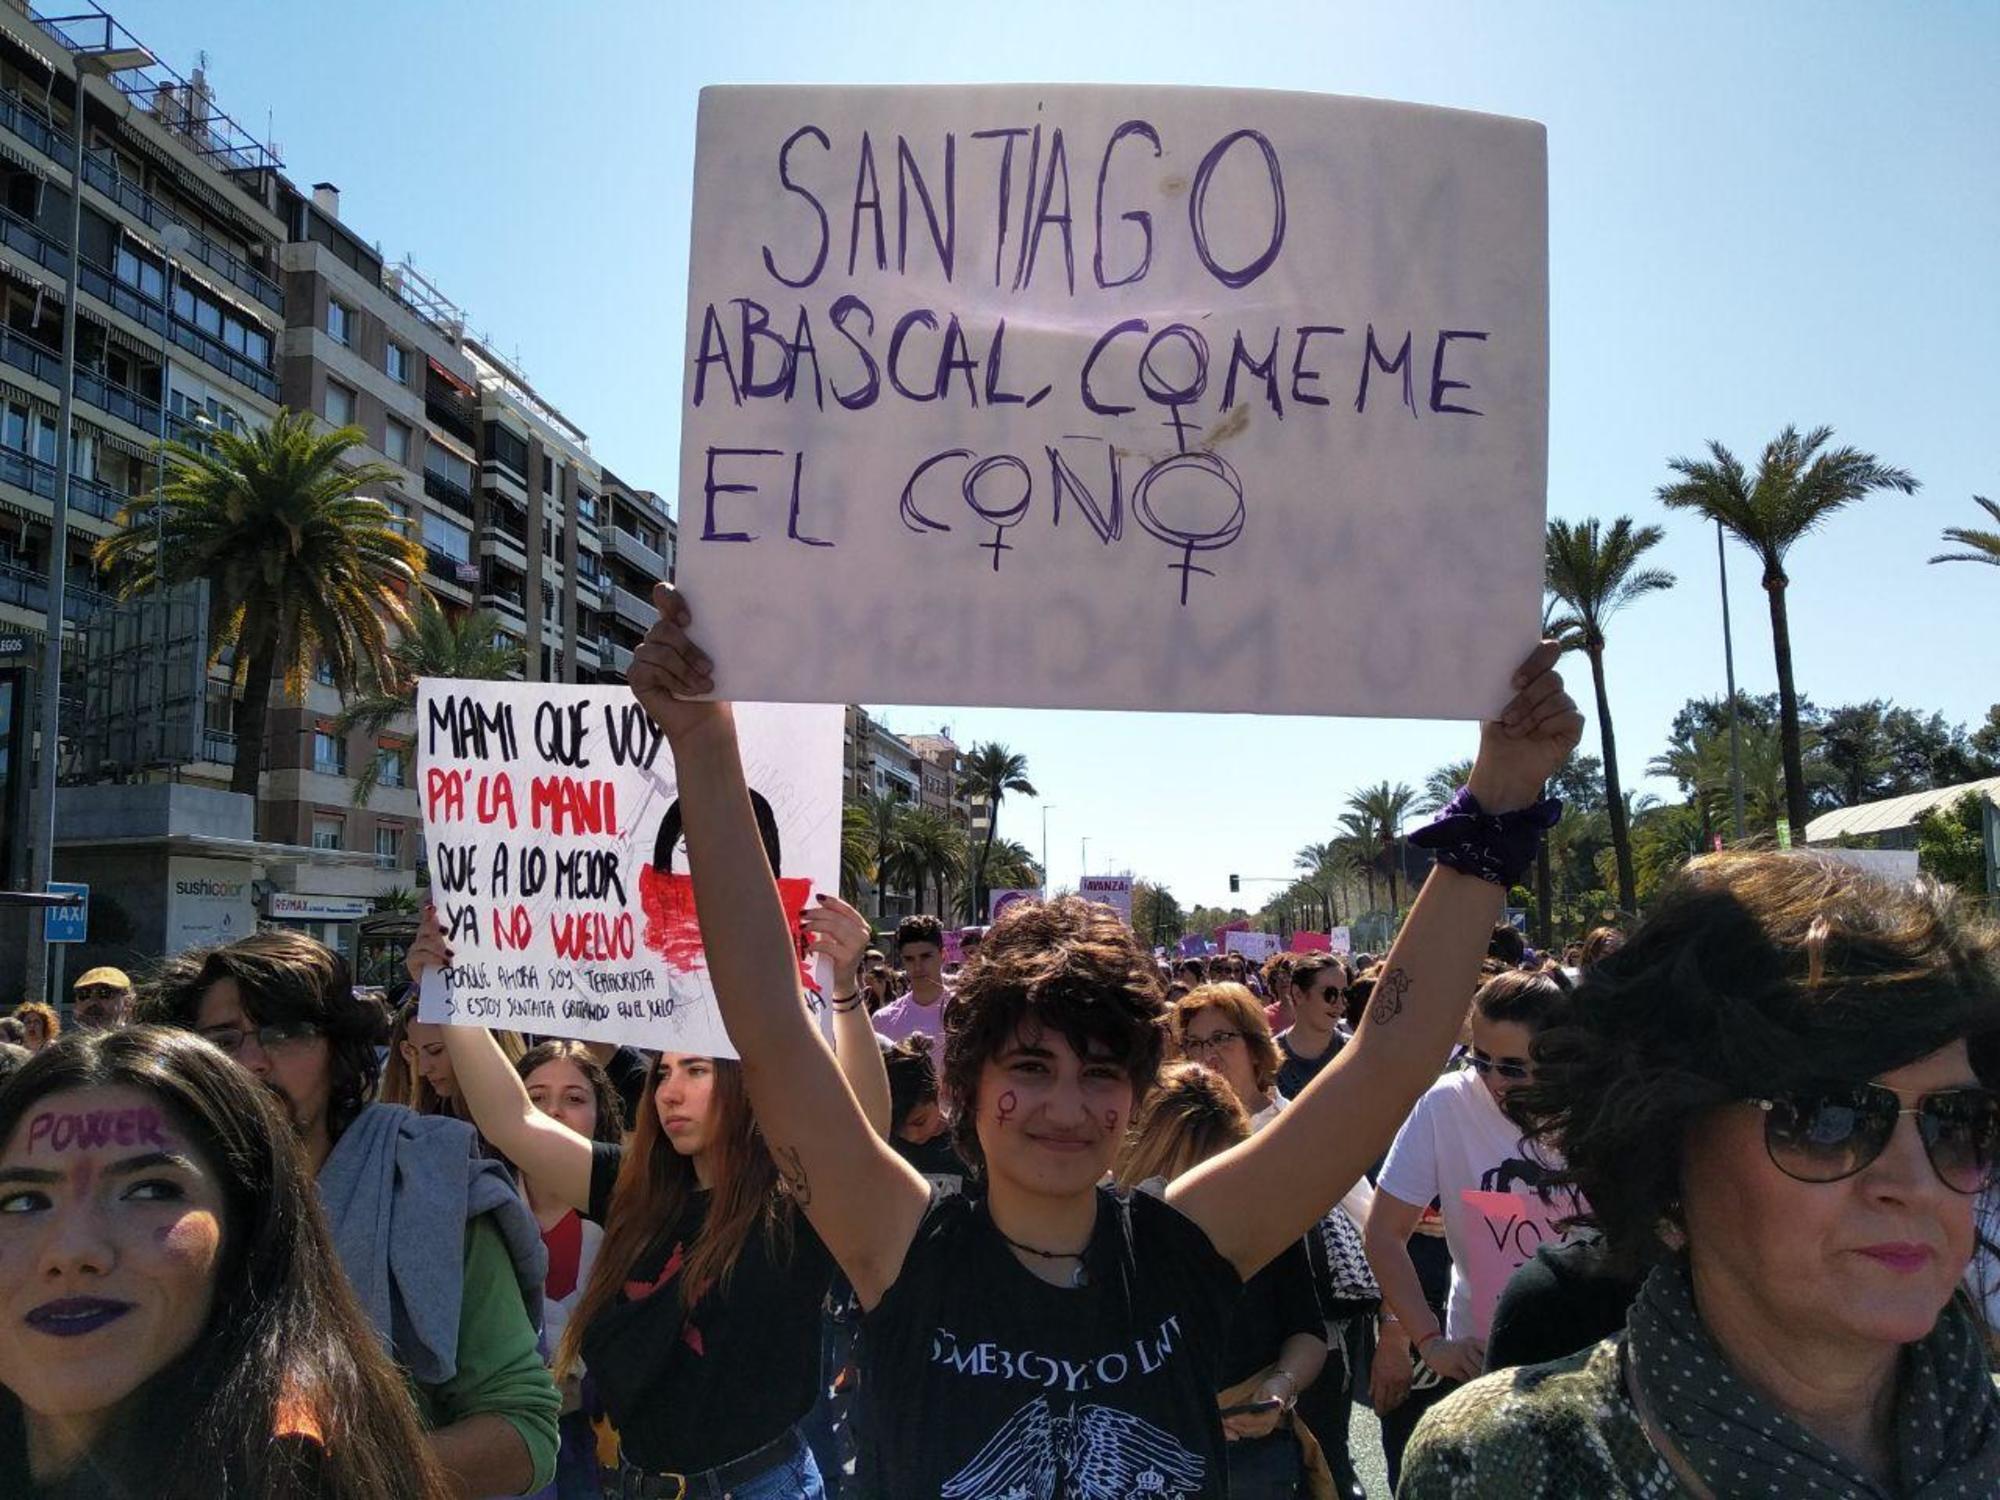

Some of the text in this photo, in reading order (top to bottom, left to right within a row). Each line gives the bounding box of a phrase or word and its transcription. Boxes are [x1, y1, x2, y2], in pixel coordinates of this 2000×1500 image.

[762, 103, 1286, 295] SANTIAGO
[693, 295, 1052, 412] ABASCAL,
[700, 435, 1246, 605] EL COÑO
[0, 639, 23, 651] EGOS
[428, 695, 664, 770] MAMI QUE VOY
[176, 879, 244, 897] sushicolor
[437, 842, 627, 907] QUE A LO MEJOR
[50, 905, 84, 921] TAXI
[446, 904, 634, 962] YA NO VUELVO
[438, 962, 656, 994] PORQUE AHORA SOY TERRORISTA
[467, 996, 501, 1018] ESTOY
[27, 1107, 168, 1155] POWER
